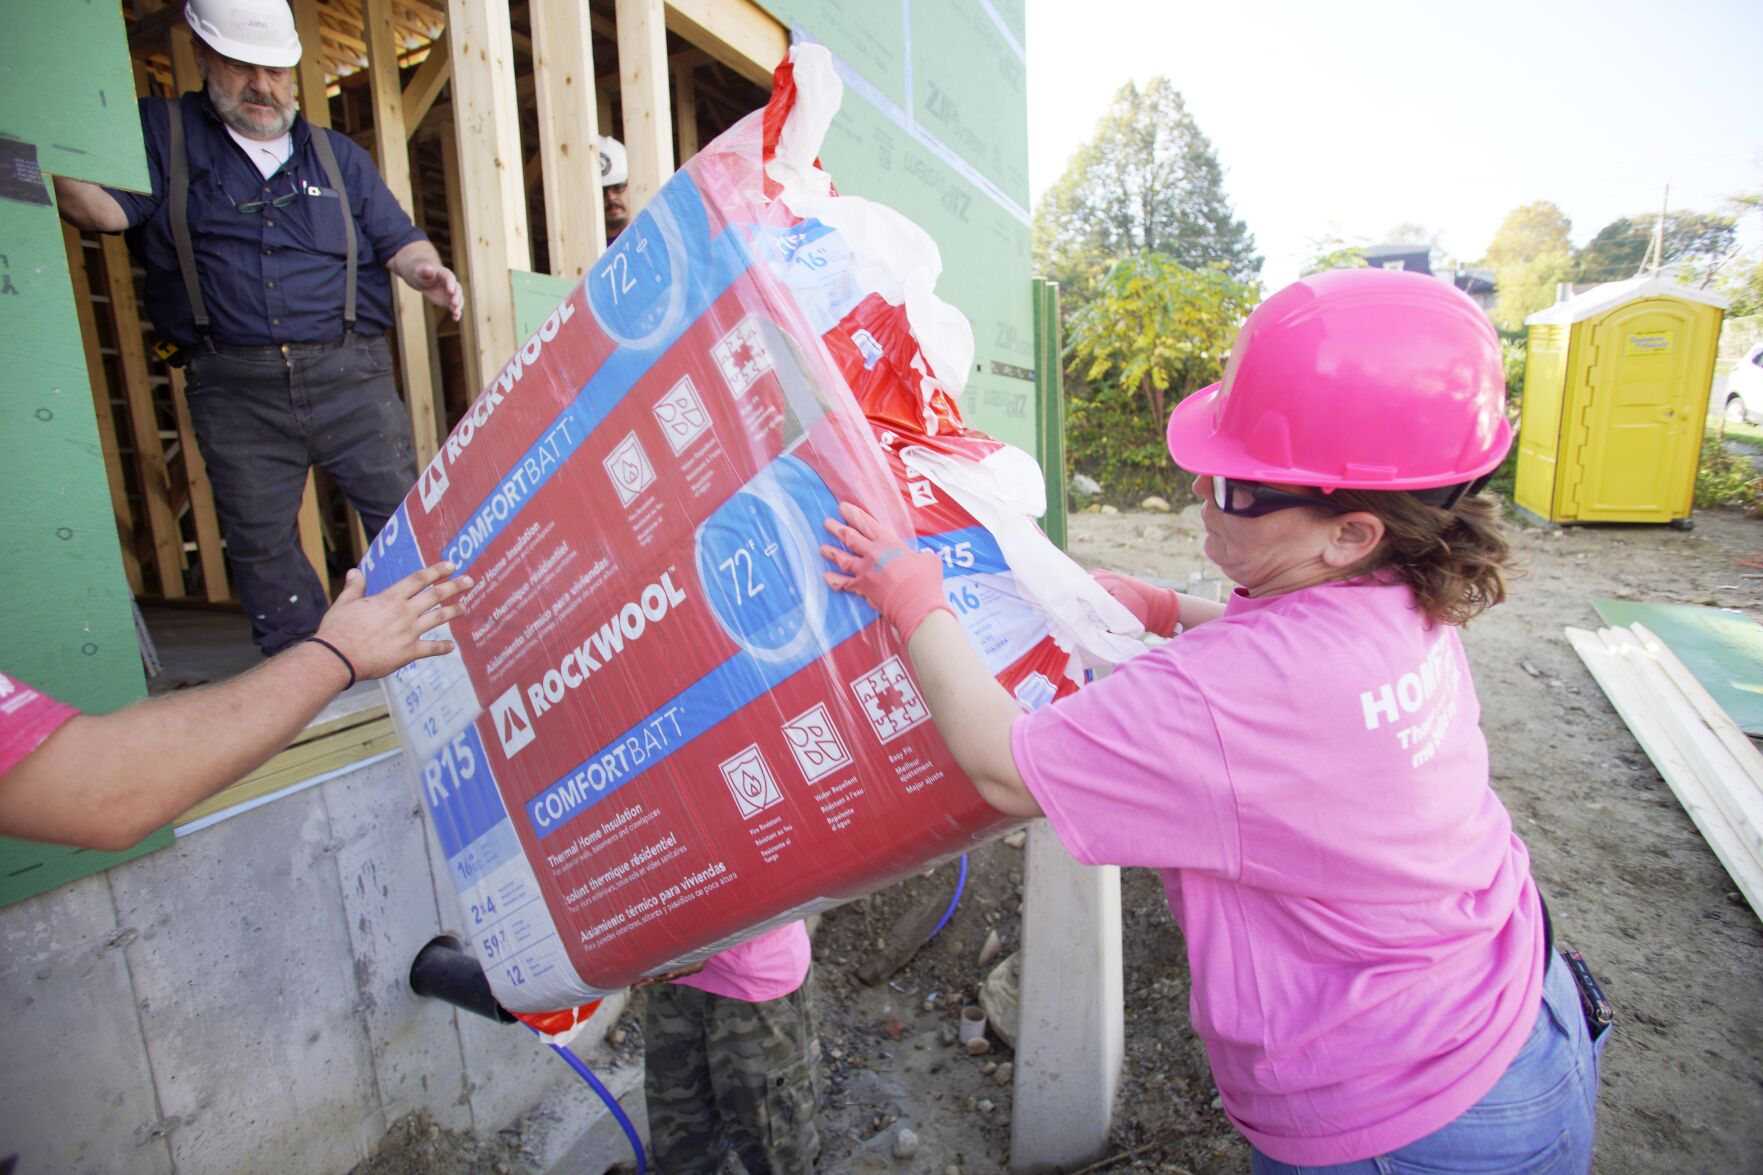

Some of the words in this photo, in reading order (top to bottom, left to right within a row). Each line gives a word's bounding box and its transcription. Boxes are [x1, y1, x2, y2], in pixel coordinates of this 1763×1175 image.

[447, 301, 575, 462] ROCKWOOL
[460, 576, 487, 605] Thermal
[484, 558, 507, 580] Home
[505, 522, 540, 559] Insulation
[491, 582, 529, 618] thermique
[528, 541, 569, 583] résidentiel
[483, 635, 524, 673] Aislamiento
[550, 593, 570, 615] para
[569, 556, 608, 594] viviendas
[424, 717, 438, 738] 12
[888, 751, 904, 762] Easy
[902, 745, 912, 754] Fit
[424, 731, 475, 807] R15
[895, 758, 919, 774] Meilleur
[900, 761, 932, 782] ajustement
[815, 790, 831, 802] Water
[831, 775, 857, 793] Repellent
[906, 781, 924, 793] Major
[924, 771, 943, 784] ajuste
[821, 796, 845, 813] Résistant
[849, 787, 864, 798] l'eau
[749, 827, 759, 835] Fire
[759, 815, 781, 830] Resistant
[827, 807, 854, 824] Repelente
[547, 842, 578, 866] Thermal
[577, 829, 601, 848] Home
[601, 802, 642, 833] Insulation
[618, 826, 628, 836] and
[755, 831, 777, 845] Résistant
[761, 841, 784, 856] Resistente
[588, 861, 630, 889] thermique
[628, 832, 676, 866] résidentiel
[703, 880, 719, 893] poca
[578, 911, 625, 942] Aislamiento
[625, 893, 658, 917] térmico
[658, 884, 679, 903] para
[680, 859, 726, 890] viviendas
[507, 965, 525, 988] 12
